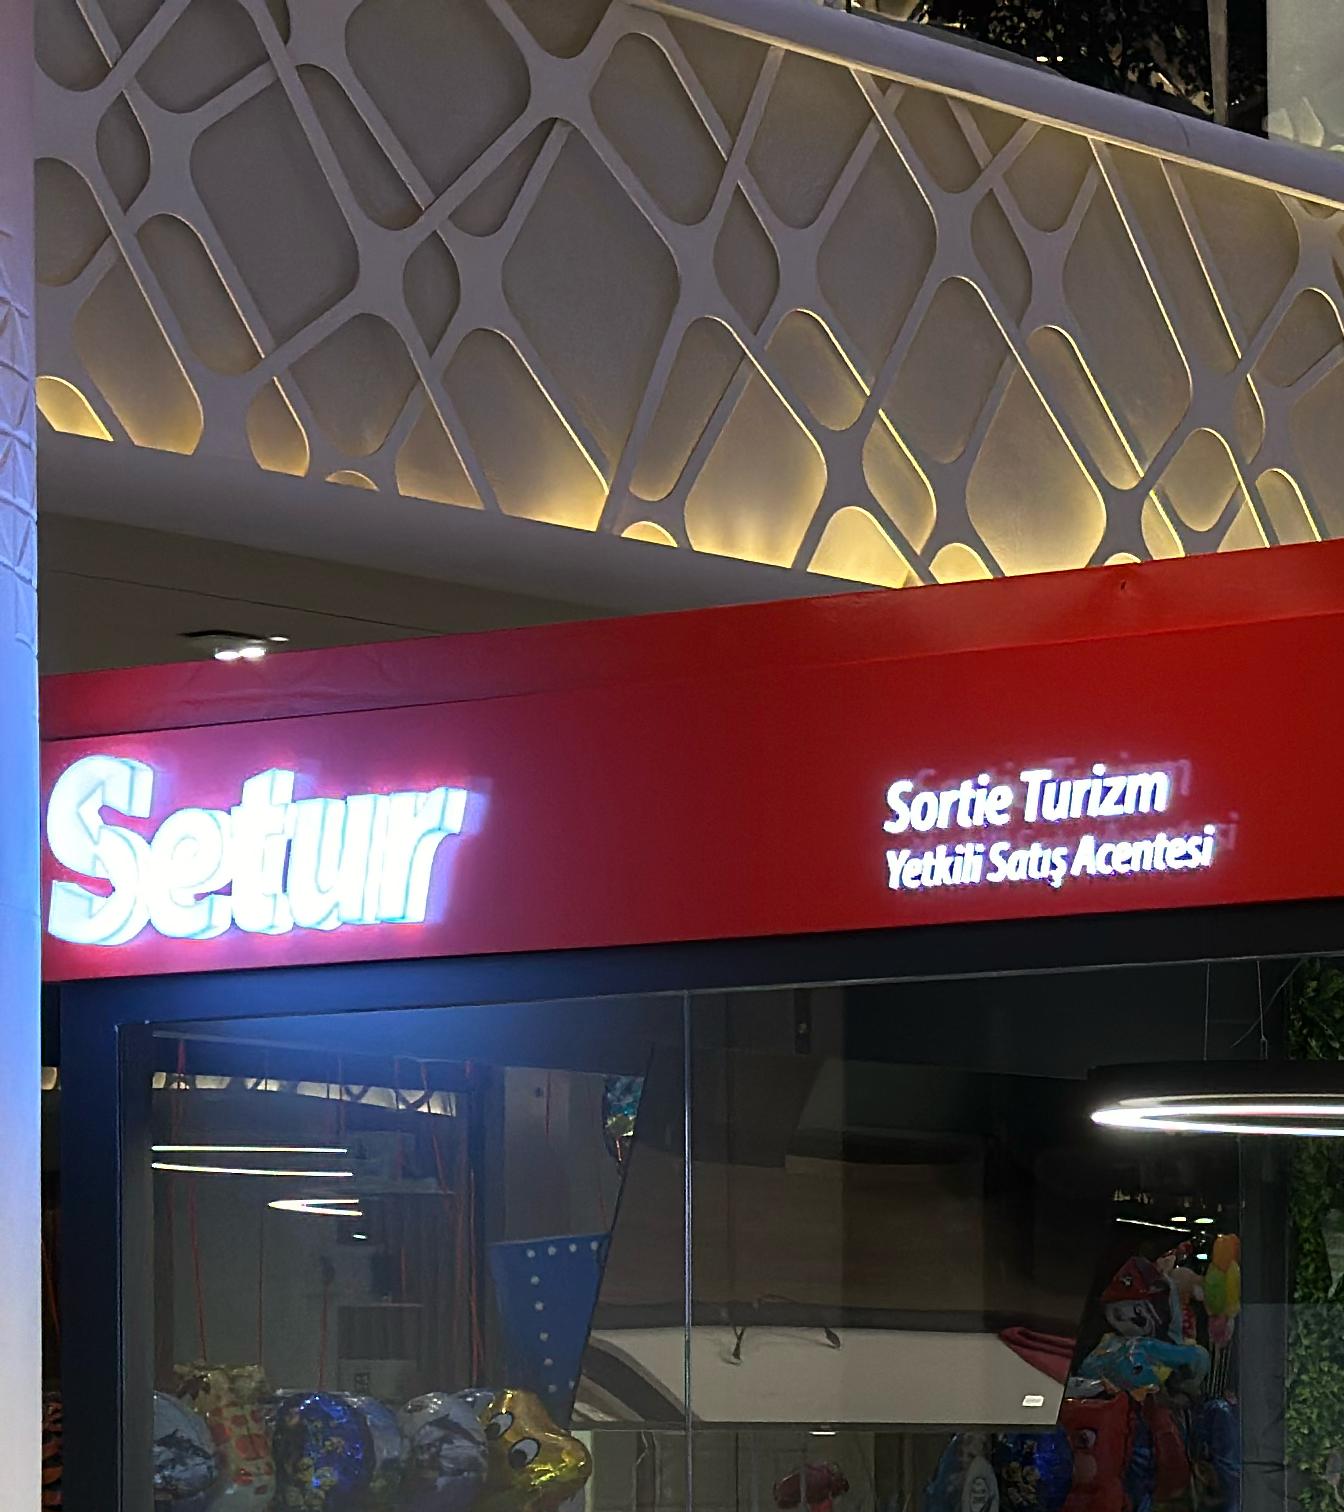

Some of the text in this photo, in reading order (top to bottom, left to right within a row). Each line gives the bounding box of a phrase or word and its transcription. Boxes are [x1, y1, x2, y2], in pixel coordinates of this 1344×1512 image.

[883, 763, 1172, 834] Sortie Turizm
[46, 754, 467, 946] Setur
[885, 823, 1218, 891] Yetkili Satış Acentesi
